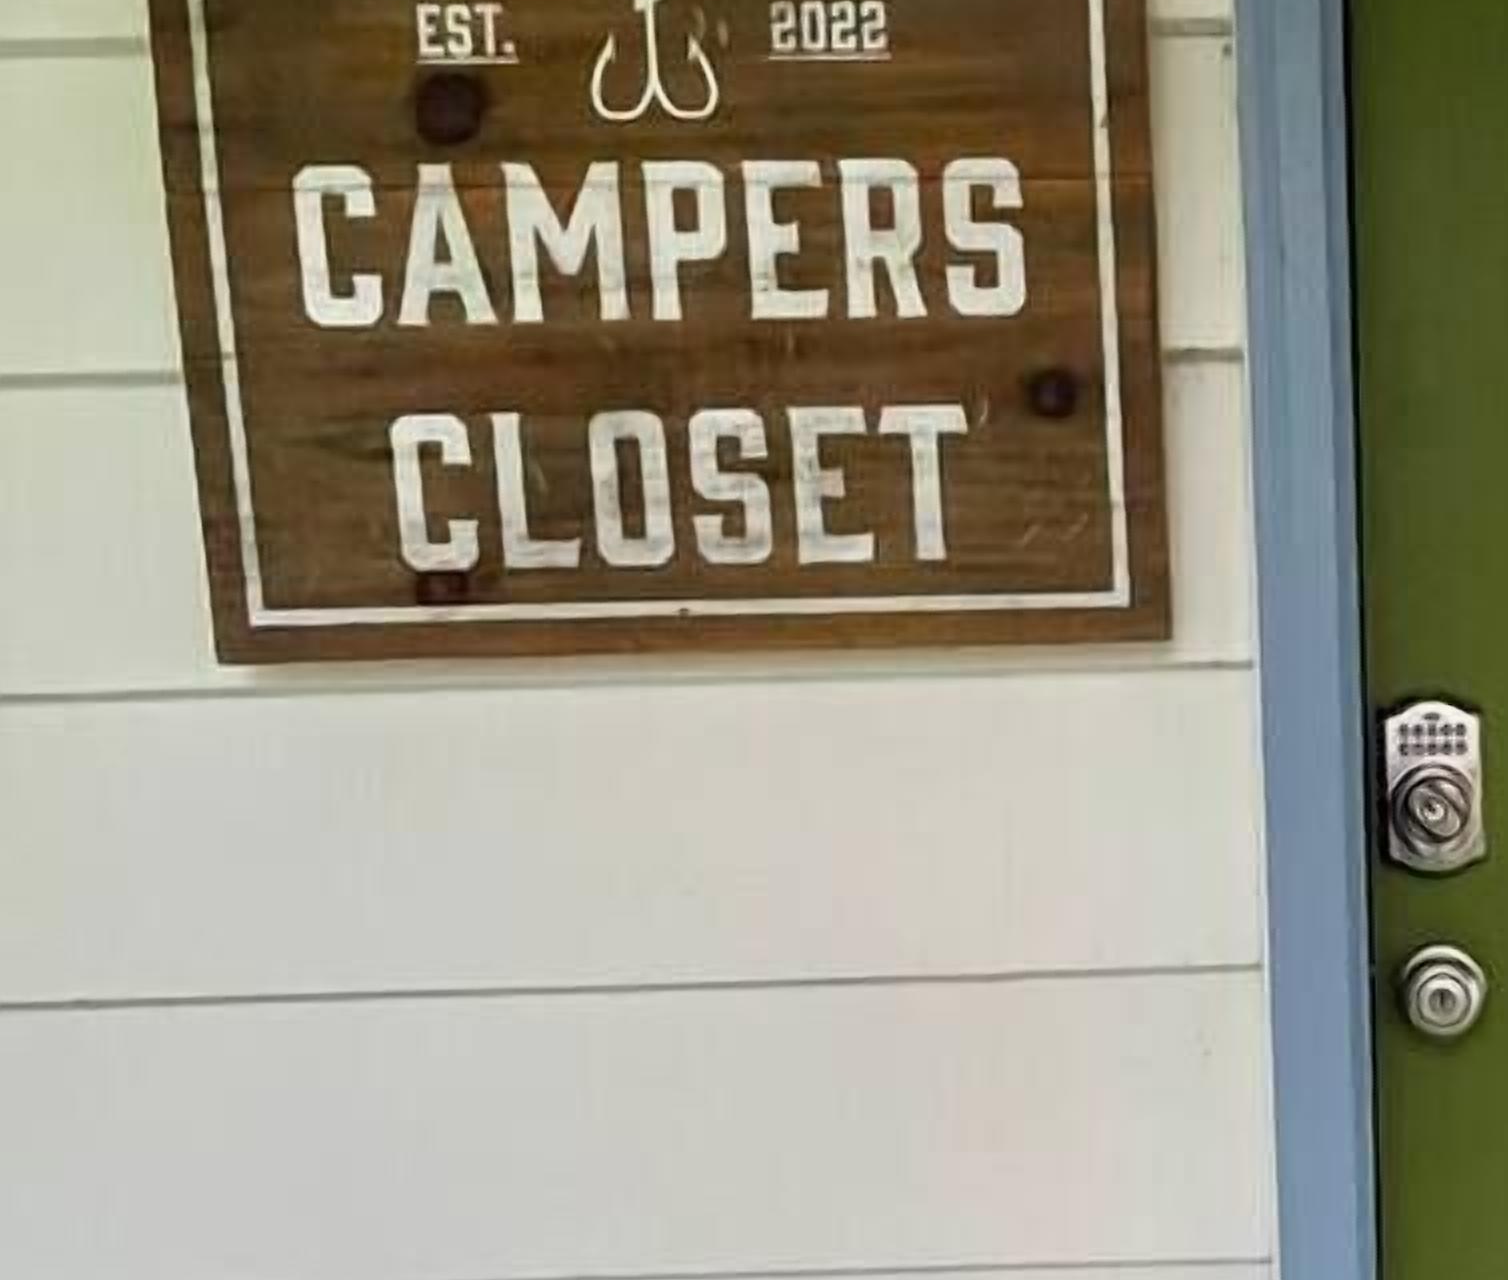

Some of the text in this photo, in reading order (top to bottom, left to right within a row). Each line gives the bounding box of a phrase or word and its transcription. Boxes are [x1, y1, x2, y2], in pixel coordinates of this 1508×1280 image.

[416, 0, 889, 57] EST. 2022
[293, 157, 1027, 327] CAMPERS
[390, 404, 968, 572] CLOSET
